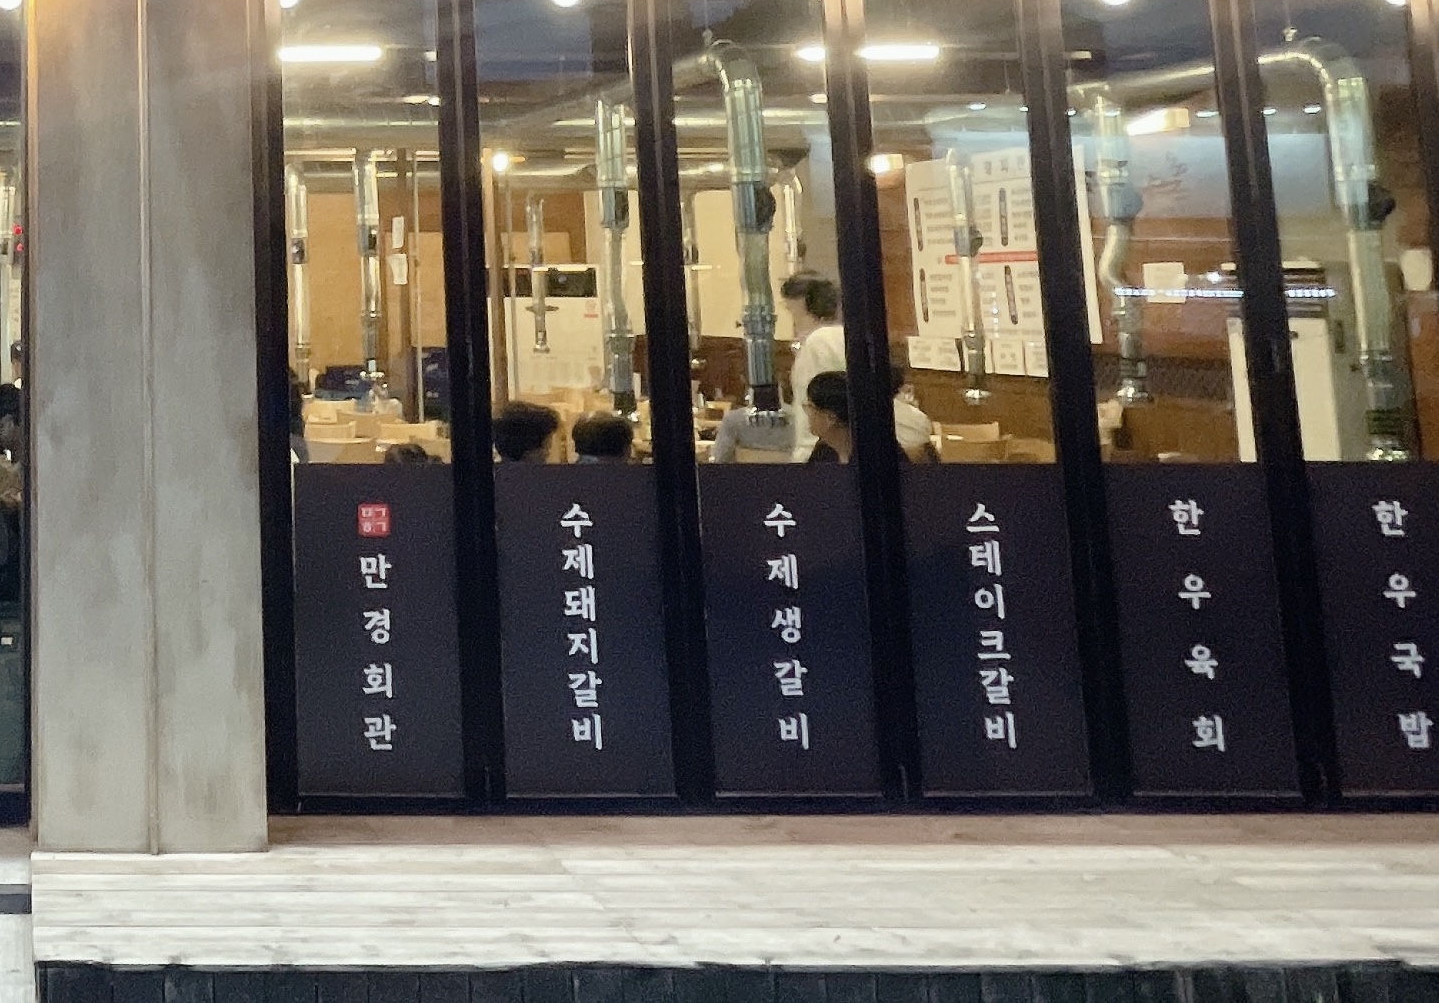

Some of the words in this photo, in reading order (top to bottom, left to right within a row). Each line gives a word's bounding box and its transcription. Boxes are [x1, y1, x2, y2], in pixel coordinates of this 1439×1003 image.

[360, 553, 397, 752] 만경회관
[560, 502, 604, 751] 수제돼지갈비
[763, 502, 810, 751] 수제생갈비
[965, 502, 1018, 750] 스테이크갈비
[1169, 499, 1227, 753] 한우육회
[1372, 499, 1434, 751] 한우국밥
